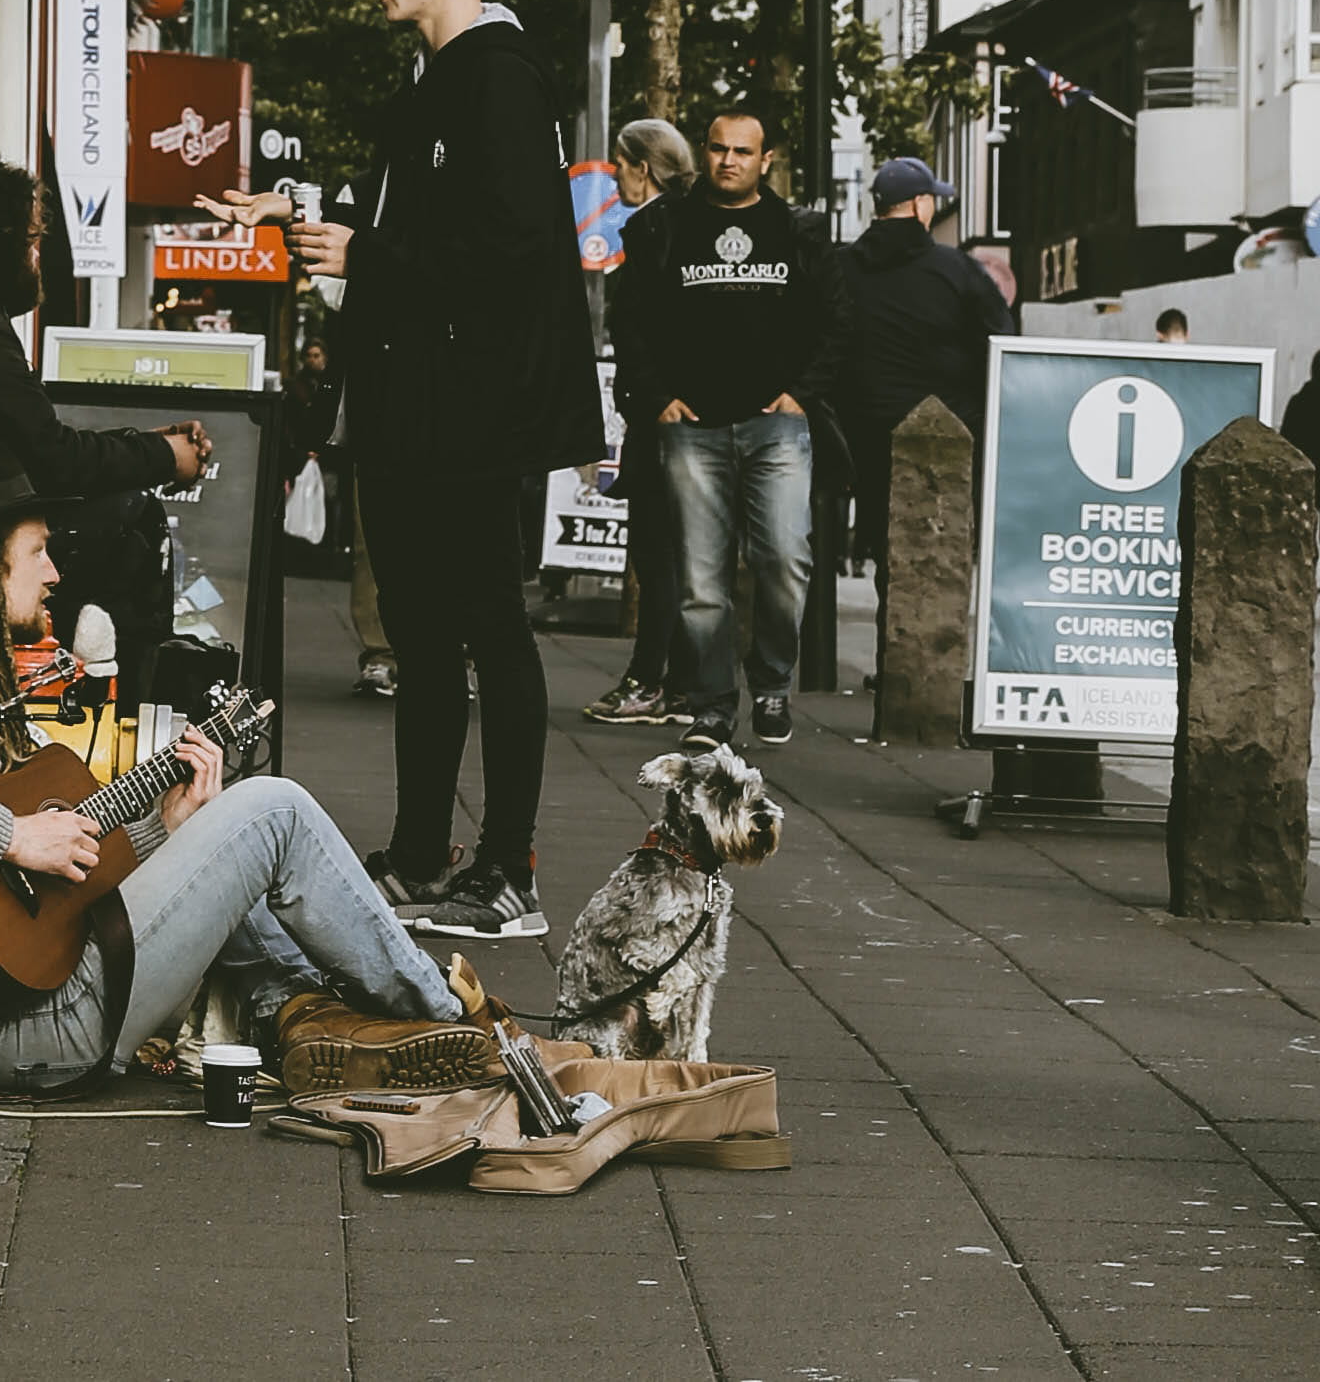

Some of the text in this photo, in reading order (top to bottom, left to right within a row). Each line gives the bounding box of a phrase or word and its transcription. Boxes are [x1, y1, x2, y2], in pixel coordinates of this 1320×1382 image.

[260, 129, 302, 160] On
[680, 262, 789, 281] MONTE CARLO
[572, 518, 584, 542] 3
[605, 520, 618, 545] 2
[1081, 503, 1166, 534] FREE
[1041, 533, 1182, 566] BOOKIN
[1055, 643, 1178, 668] EXCHANGE
[995, 685, 1070, 724] ITA
[1082, 688, 1161, 707] ICELAND
